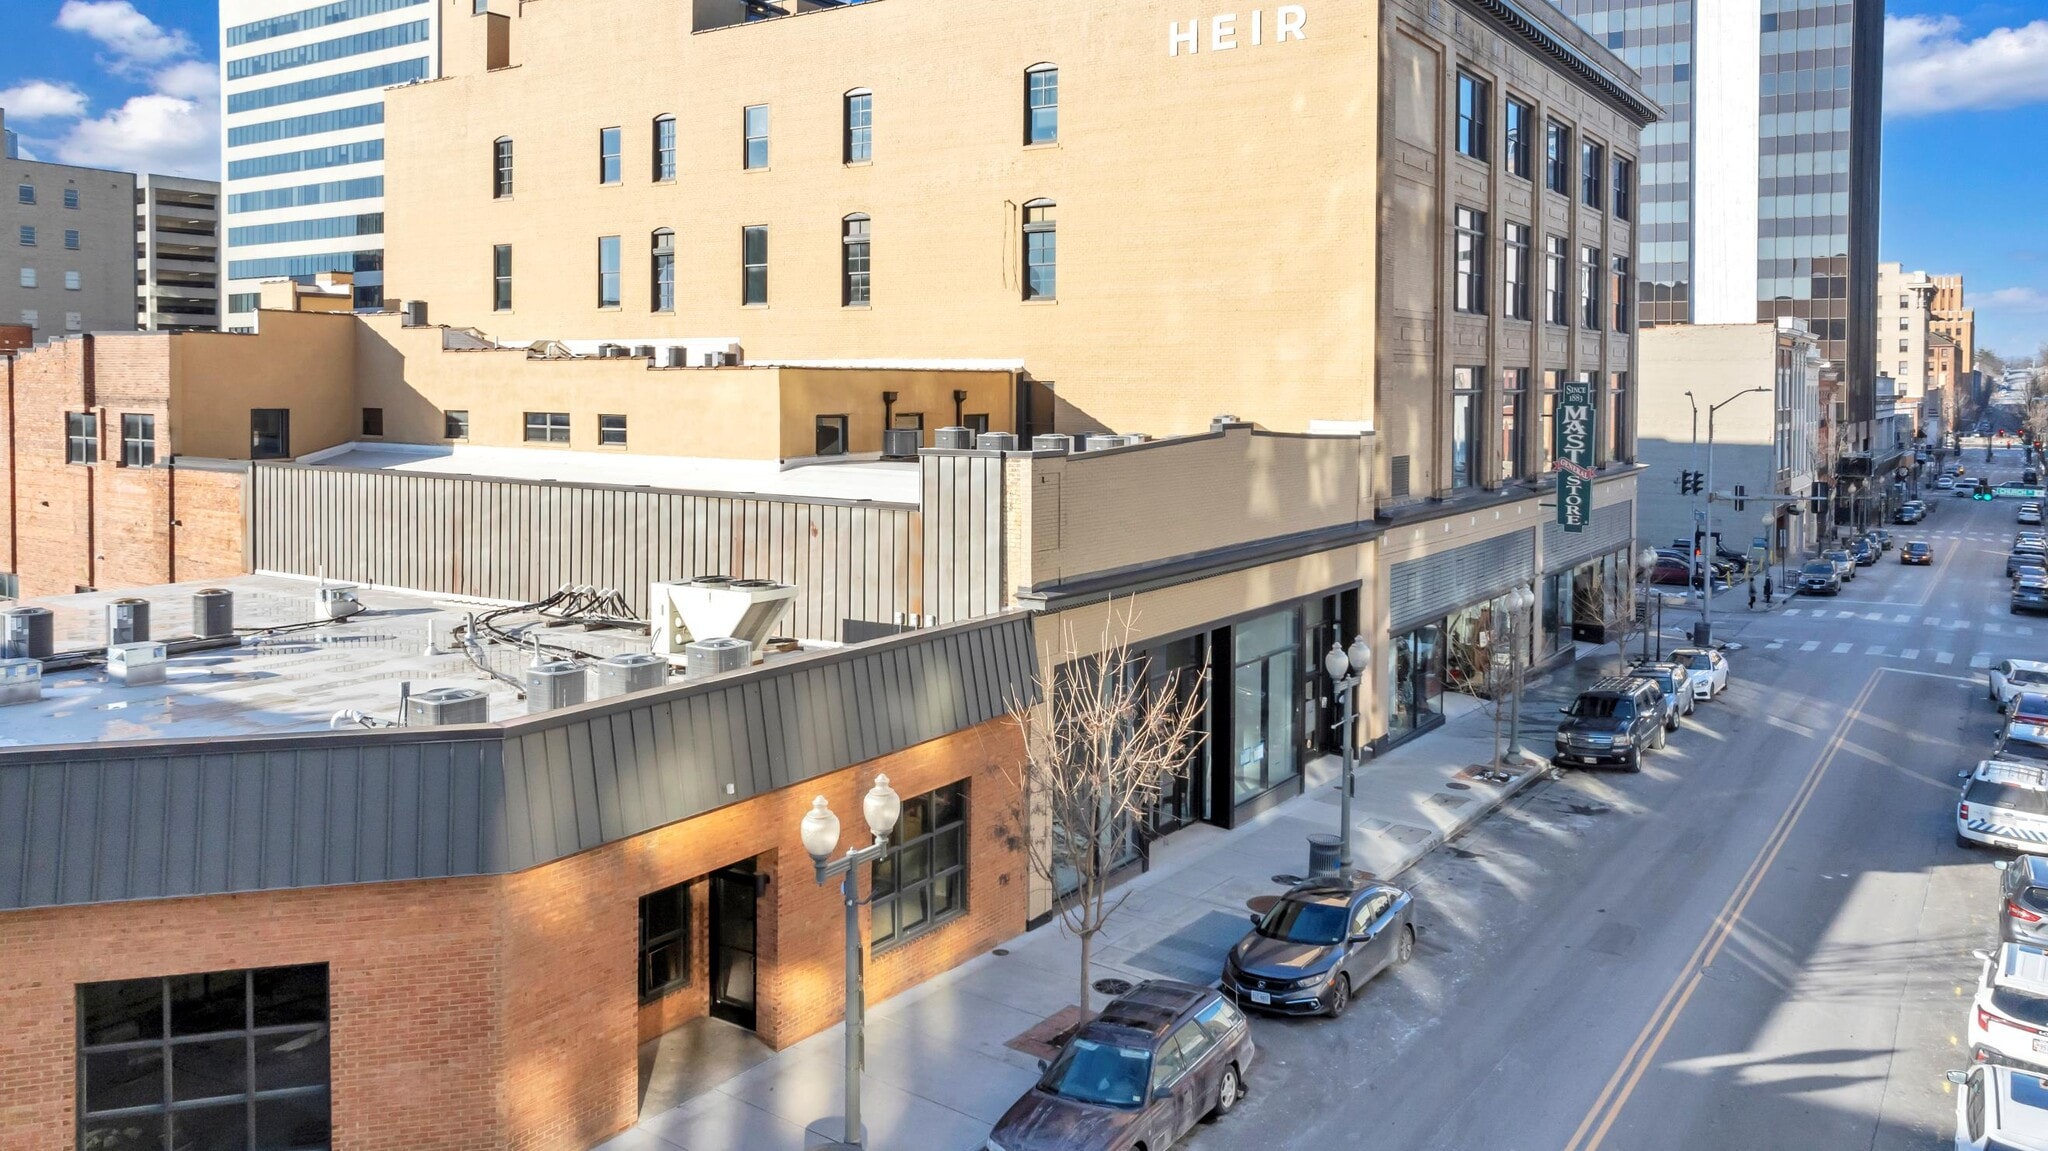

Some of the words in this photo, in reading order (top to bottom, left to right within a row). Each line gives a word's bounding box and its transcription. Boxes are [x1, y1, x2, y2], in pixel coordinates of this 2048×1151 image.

[1168, 4, 1307, 57] HEIR
[1566, 385, 1586, 394] SINCE
[1569, 394, 1583, 403] 1883
[1562, 405, 1588, 464] MAST
[1560, 459, 1589, 478] GENERAL
[1565, 475, 1582, 525] STORE
